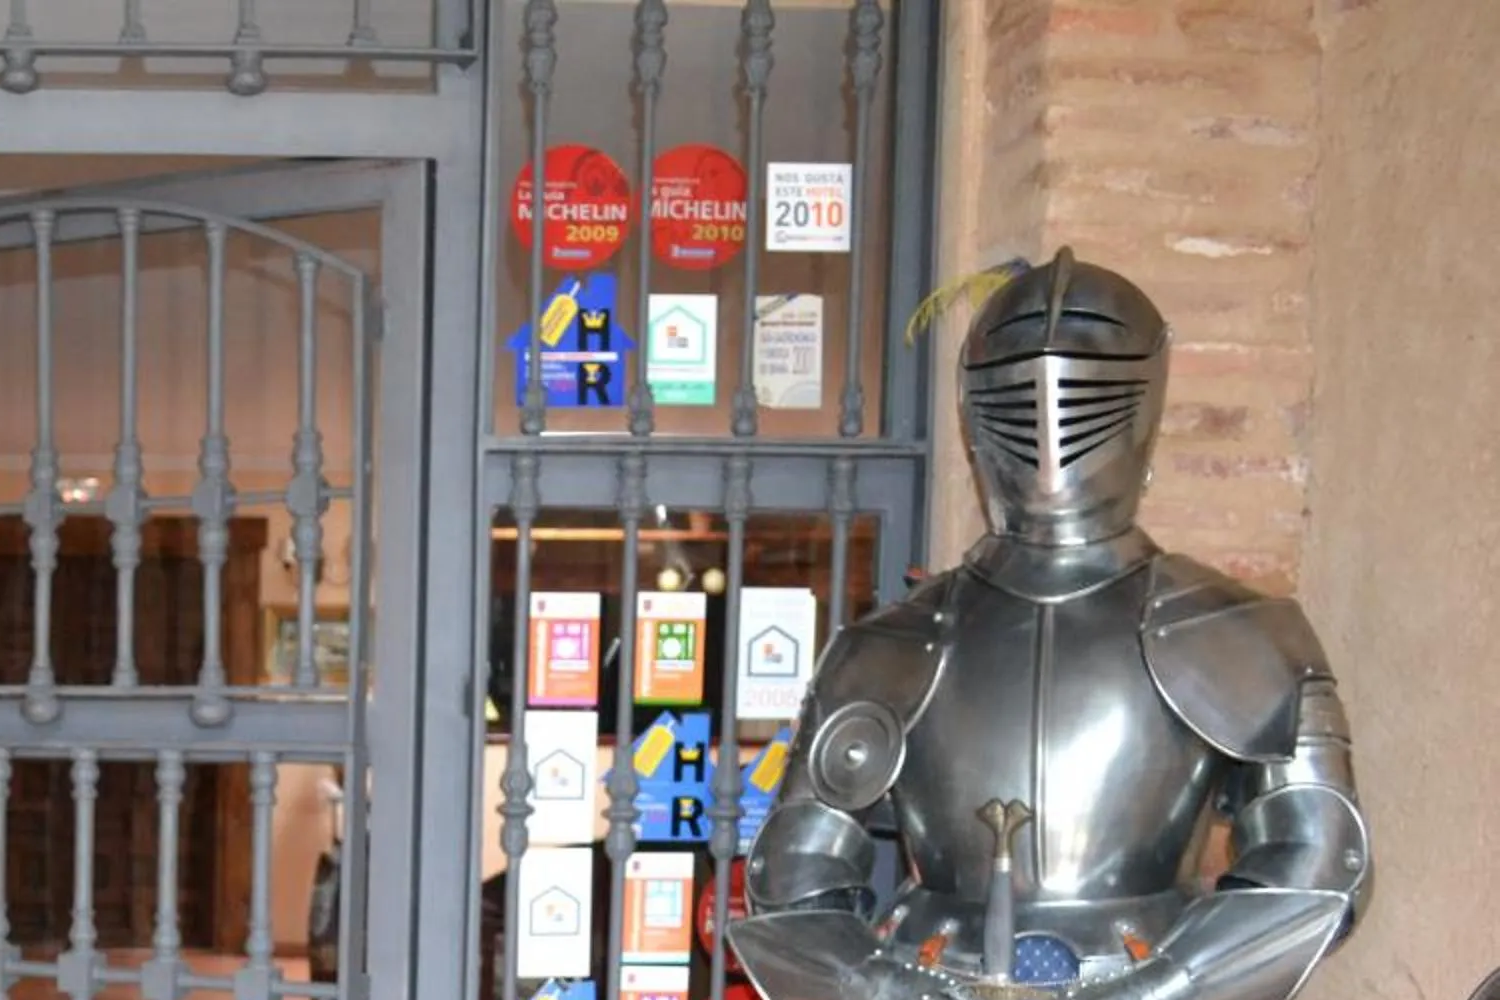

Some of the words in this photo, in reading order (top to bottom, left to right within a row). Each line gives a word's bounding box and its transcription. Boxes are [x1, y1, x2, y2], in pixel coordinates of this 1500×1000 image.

[518, 203, 627, 221] MCHELIN
[775, 200, 843, 227] 2010
[565, 224, 619, 242] 2009
[691, 223, 744, 241] 2010
[673, 742, 705, 782] H
[671, 797, 704, 836] R
